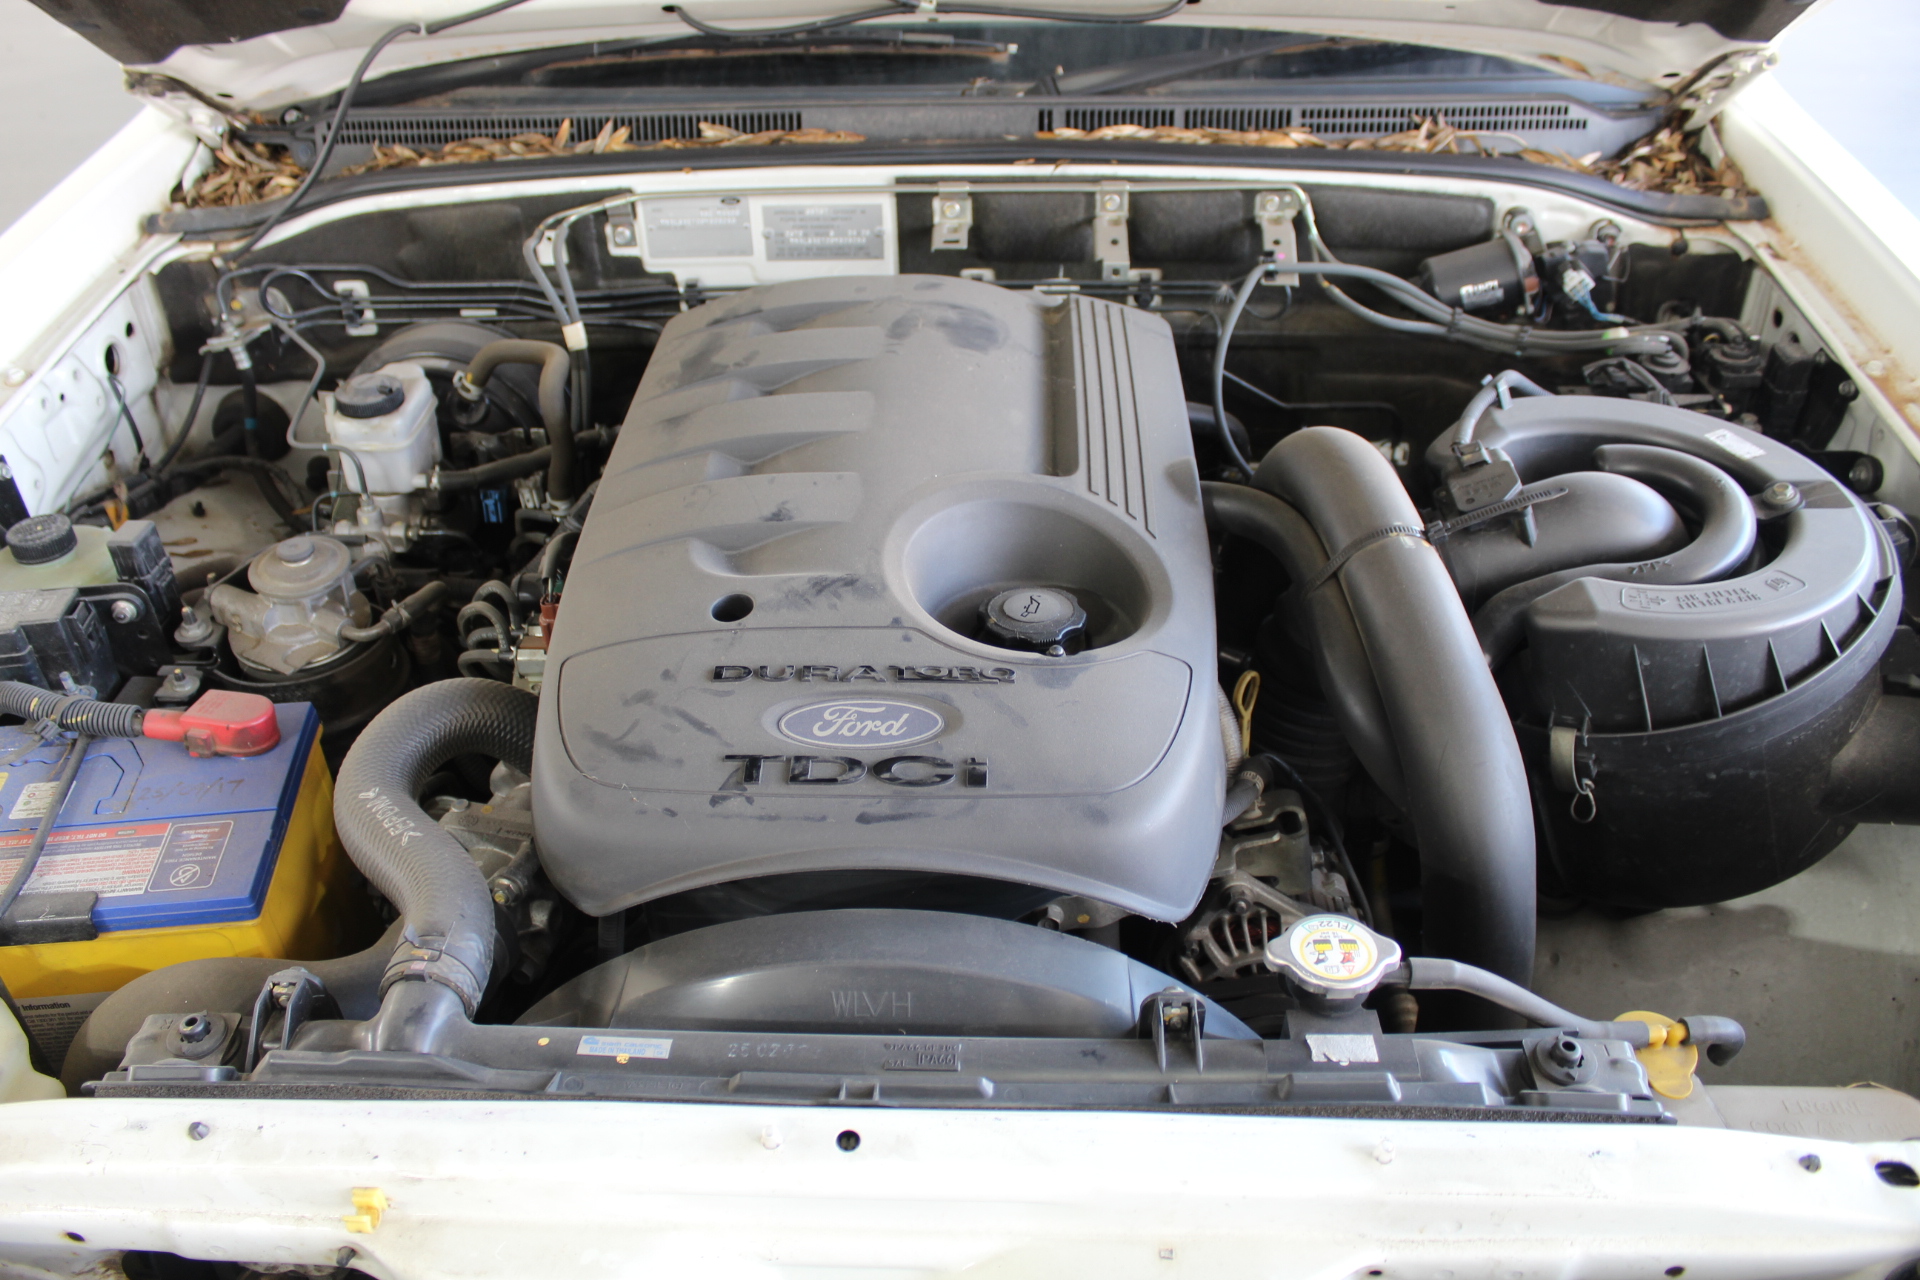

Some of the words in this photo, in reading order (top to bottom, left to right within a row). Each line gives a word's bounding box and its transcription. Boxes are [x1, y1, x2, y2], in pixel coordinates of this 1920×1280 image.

[812, 705, 913, 738] Ford
[722, 754, 990, 788] TDCi
[1318, 920, 1349, 930] FL22
[21, 1002, 71, 1011] Information
